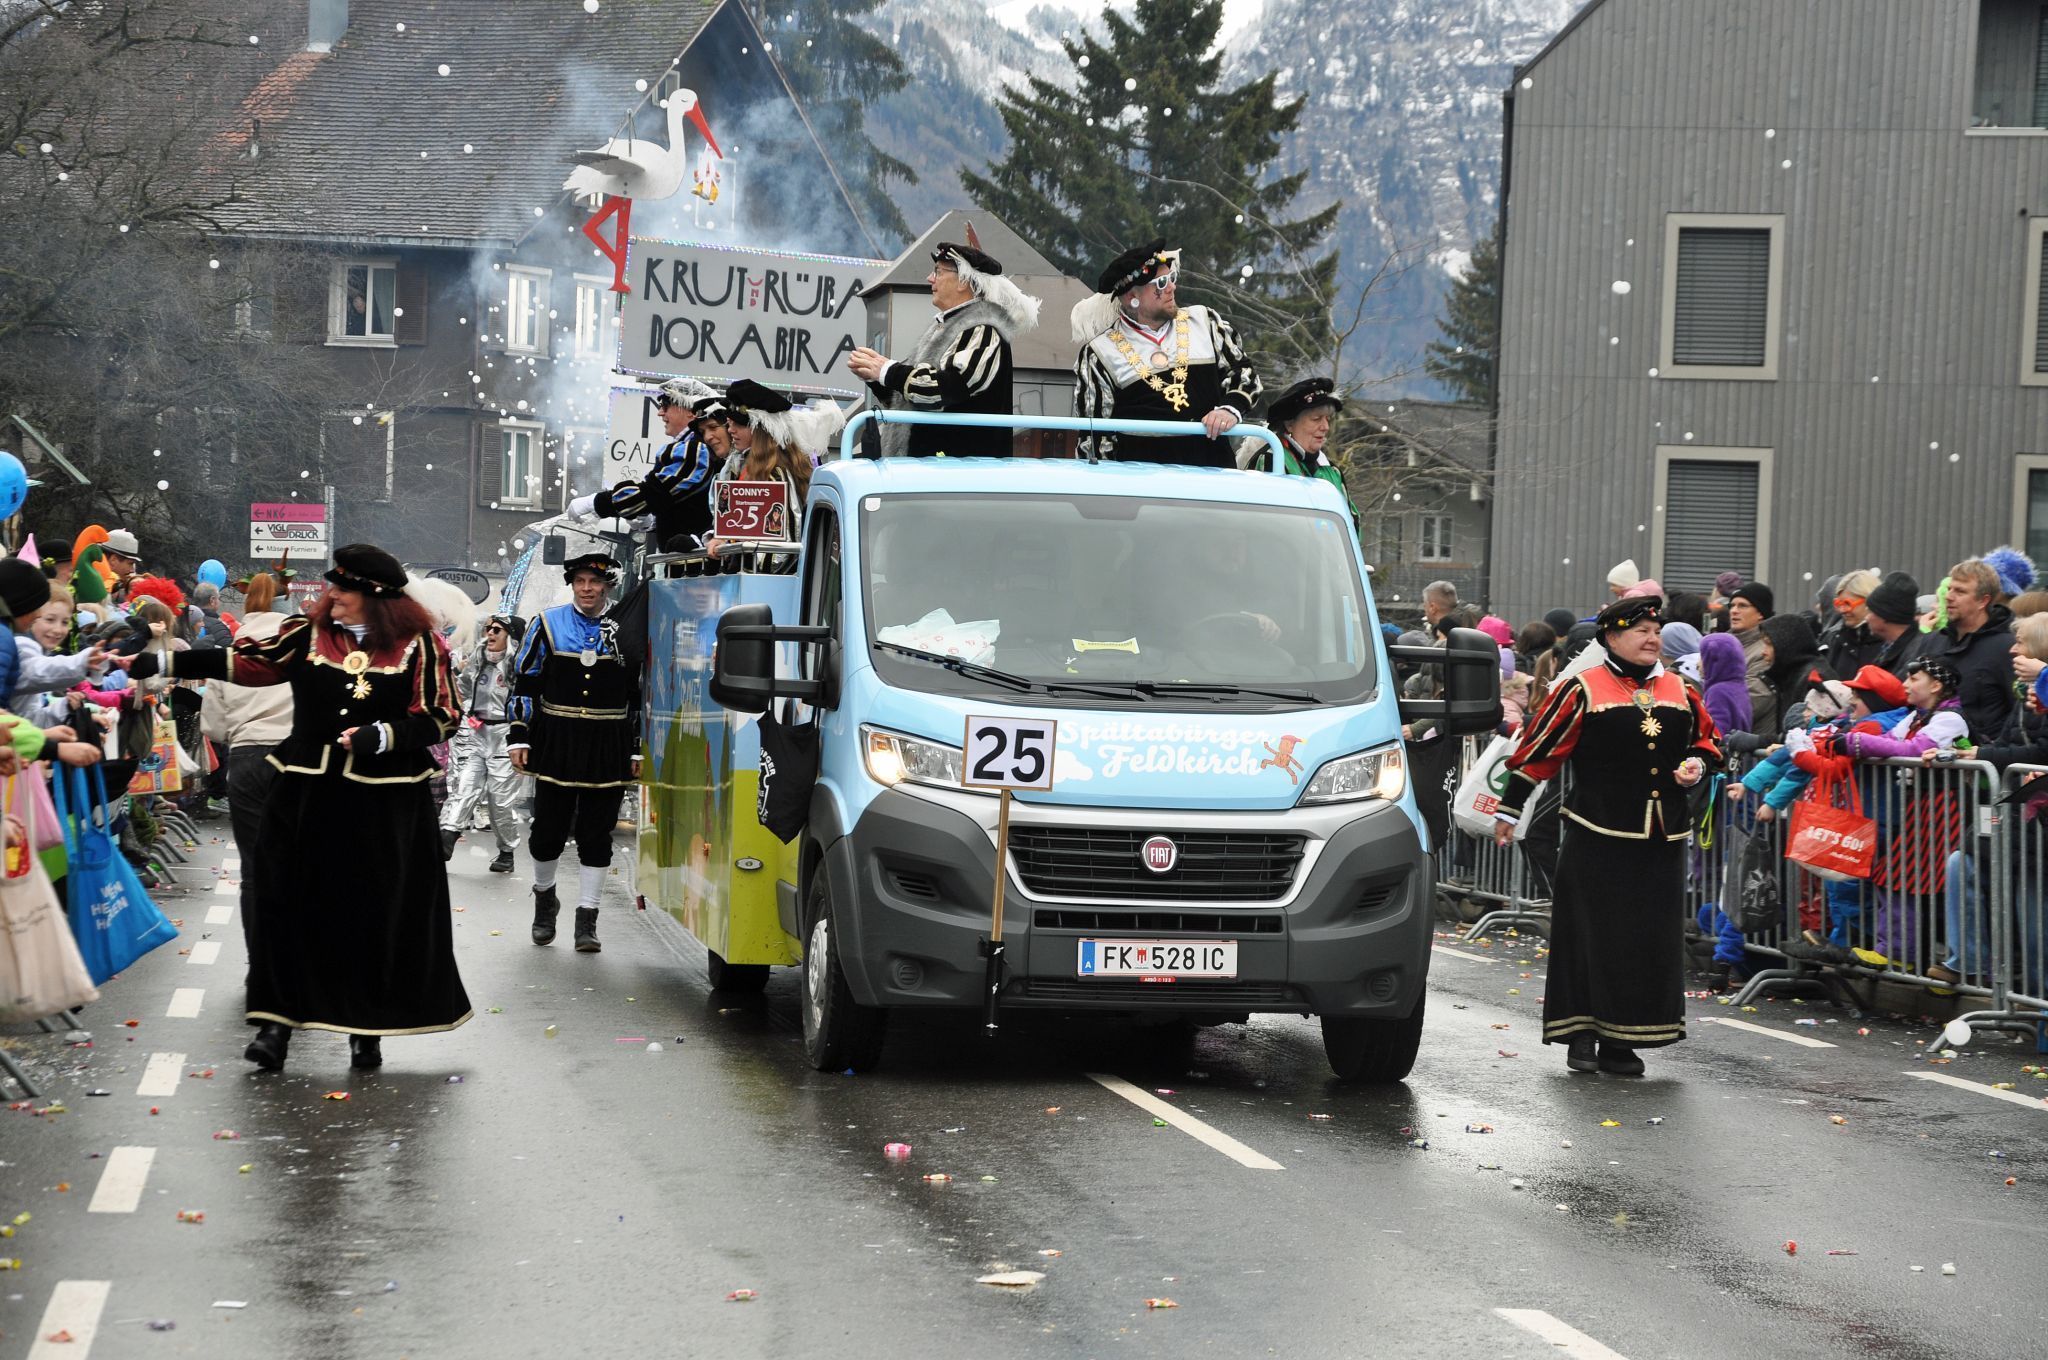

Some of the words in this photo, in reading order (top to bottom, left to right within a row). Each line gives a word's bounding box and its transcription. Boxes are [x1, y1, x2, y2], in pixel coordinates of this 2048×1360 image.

[643, 257, 748, 310] KRUT
[763, 269, 864, 320] RÜBA
[610, 439, 657, 465] GAL
[731, 487, 771, 498] CONNY'S
[725, 505, 759, 530] 25
[437, 572, 479, 583] HOUSTON
[972, 726, 1046, 783] 25
[1097, 743, 1264, 778] Feldkirch
[1150, 847, 1171, 863] FIAT
[1103, 946, 1133, 970] FK
[1151, 946, 1196, 971] 528
[1203, 947, 1224, 971] IC
